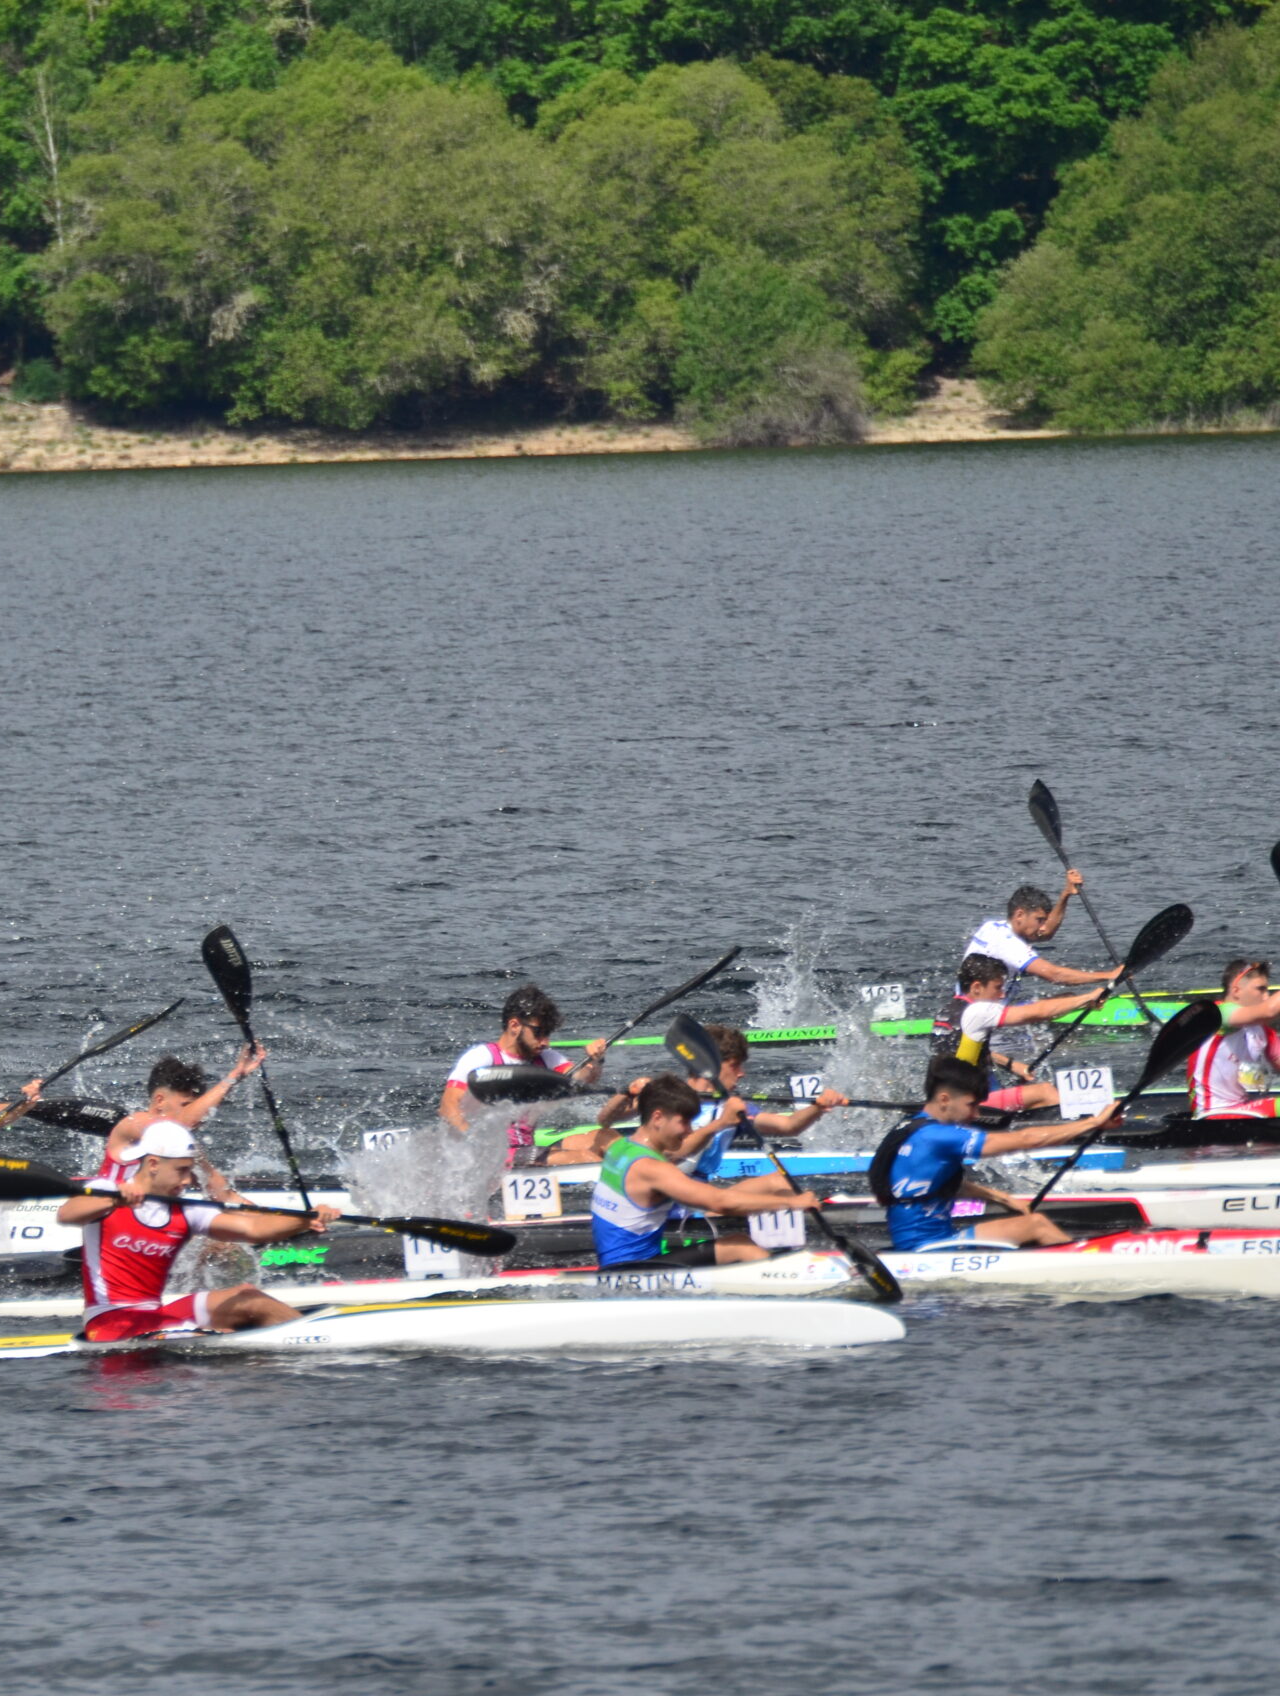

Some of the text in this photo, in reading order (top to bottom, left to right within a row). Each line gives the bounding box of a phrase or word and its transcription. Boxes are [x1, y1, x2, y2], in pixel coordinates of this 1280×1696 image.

[795, 1077, 822, 1098] 12
[1064, 1069, 1103, 1091] 102
[369, 1126, 396, 1150] 10
[508, 1178, 552, 1200] 123
[950, 1255, 1001, 1273] ESP
